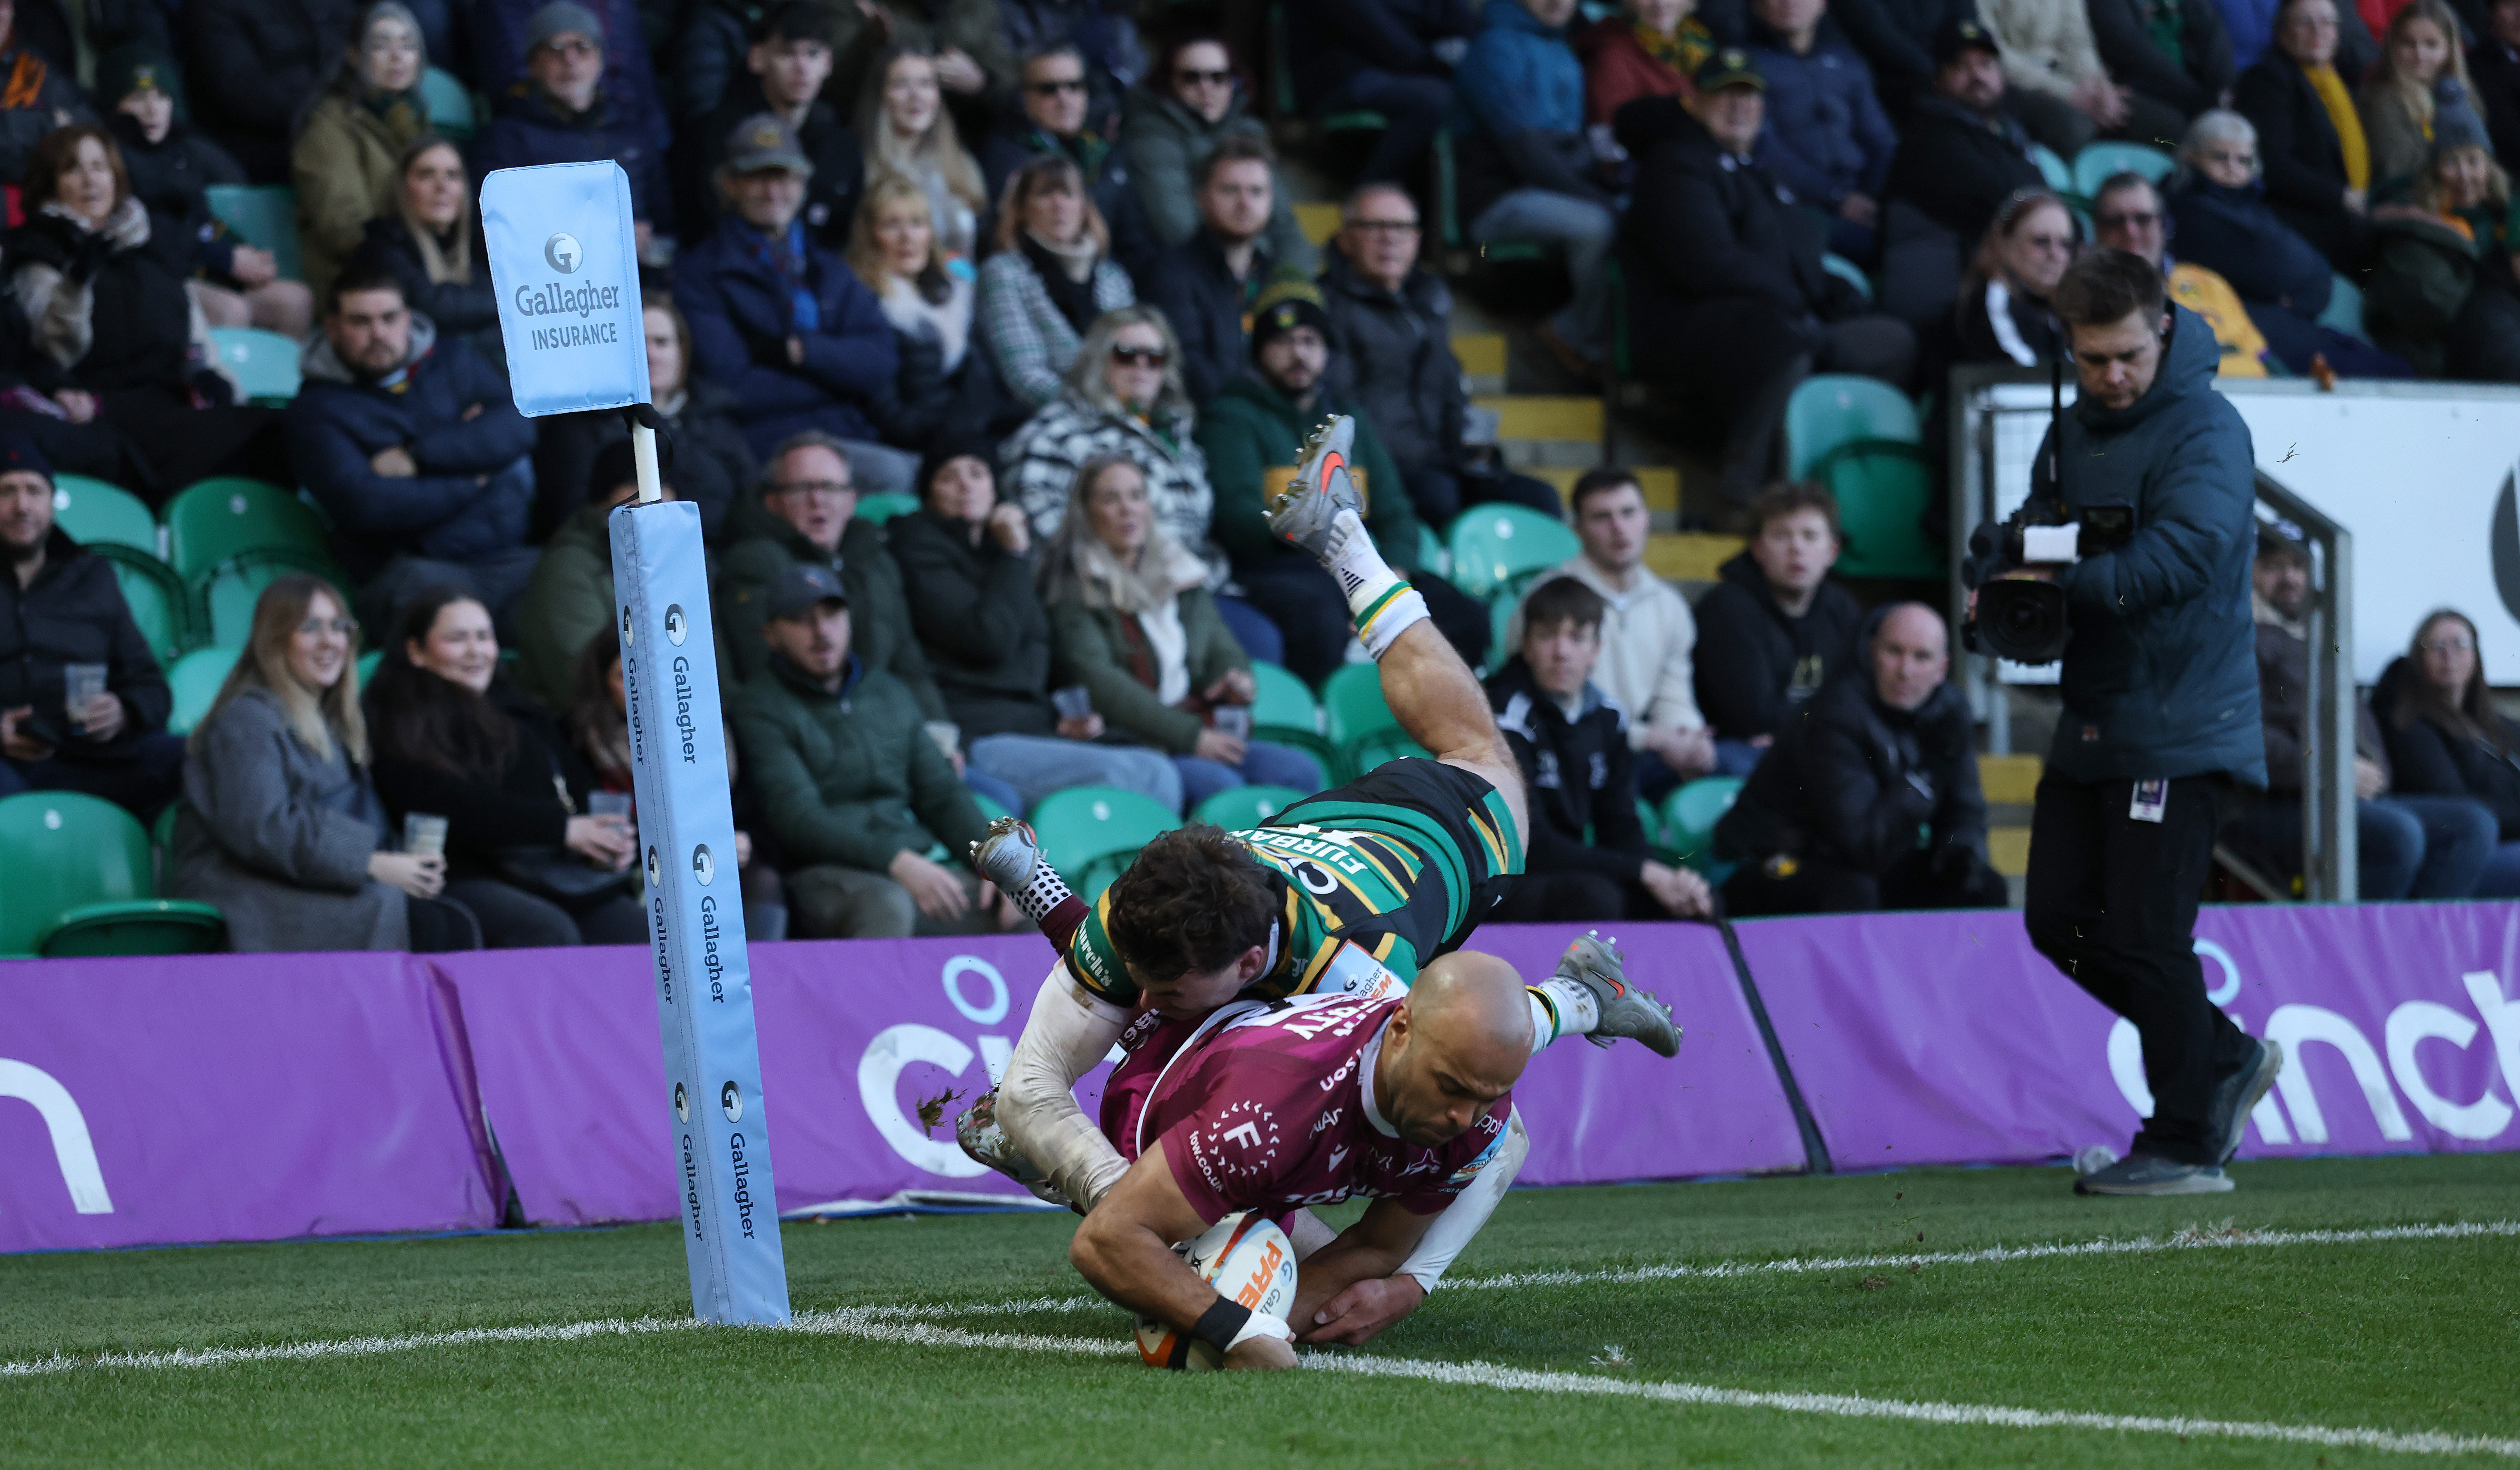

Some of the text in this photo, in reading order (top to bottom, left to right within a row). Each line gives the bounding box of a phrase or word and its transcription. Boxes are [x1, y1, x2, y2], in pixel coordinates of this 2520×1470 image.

[515, 280, 619, 318] Gallagher
[532, 323, 617, 351] INSURANCE
[628, 657, 644, 765] Gallagher
[673, 656, 696, 764] Gallagher
[1226, 829, 1368, 875] FURBAN
[655, 897, 672, 1005] Gallagher
[701, 896, 724, 1003] Gallagher
[1356, 967, 1382, 998] agher
[1370, 974, 1392, 999] EM
[683, 1133, 703, 1241] Gallagher
[730, 1132, 755, 1240] Gallagher
[1235, 1240, 1283, 1310] PRE
